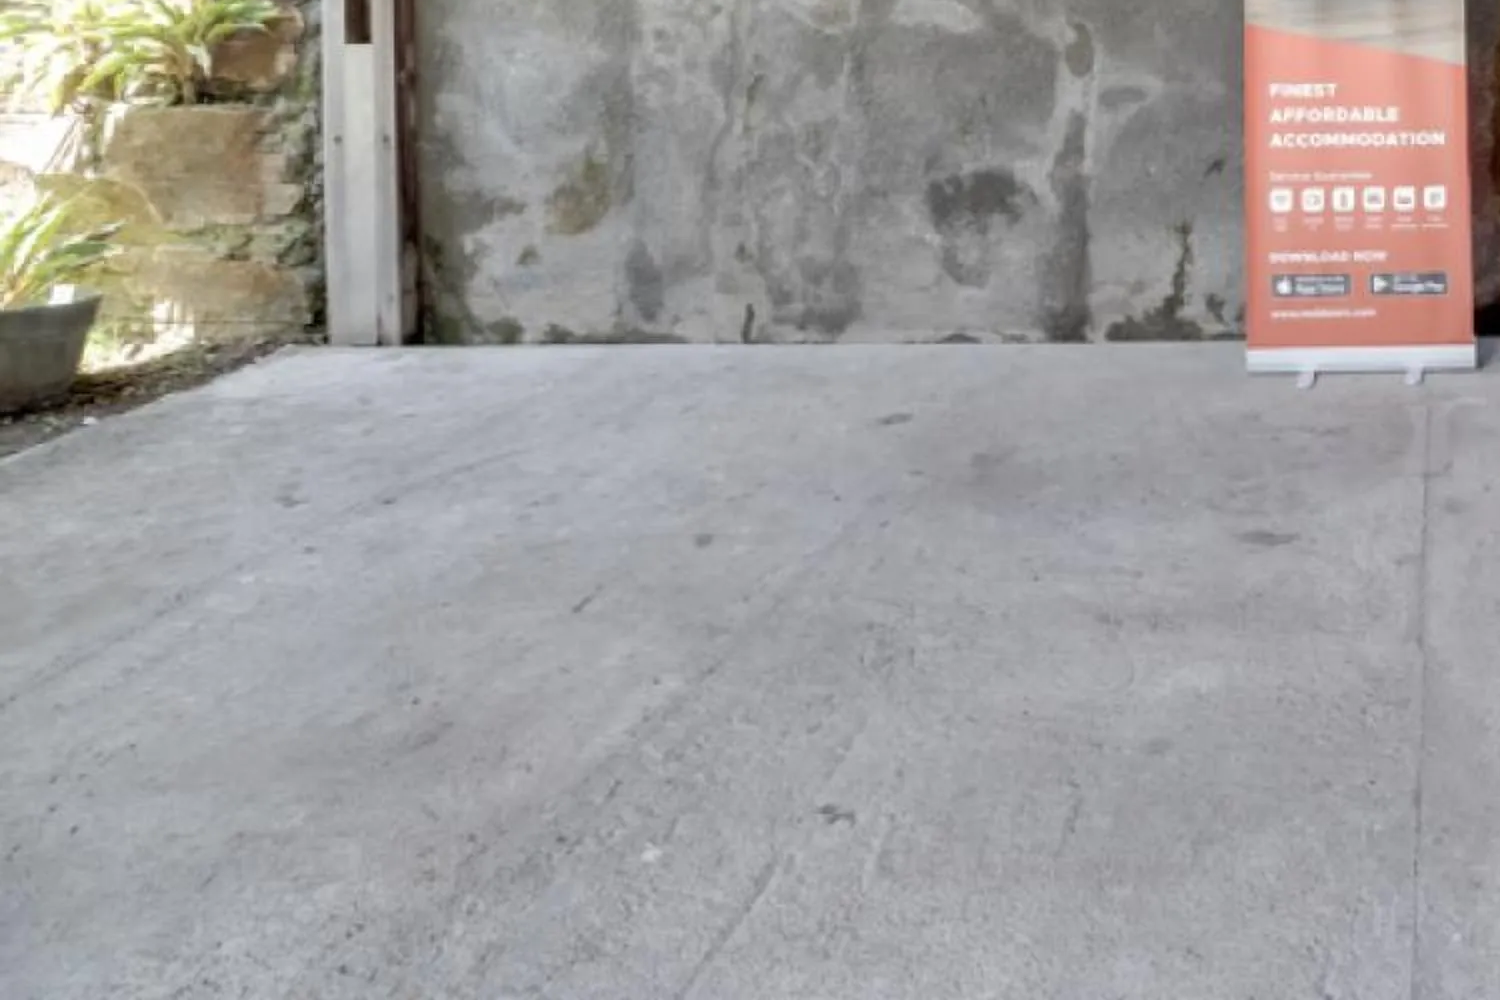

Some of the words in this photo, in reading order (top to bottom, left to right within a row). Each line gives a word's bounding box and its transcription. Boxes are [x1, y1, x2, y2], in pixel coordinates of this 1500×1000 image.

[1269, 83, 1337, 98] FINEST
[1269, 106, 1399, 123] AFFORDABLE
[1269, 130, 1446, 148] ACCOMMODATION
